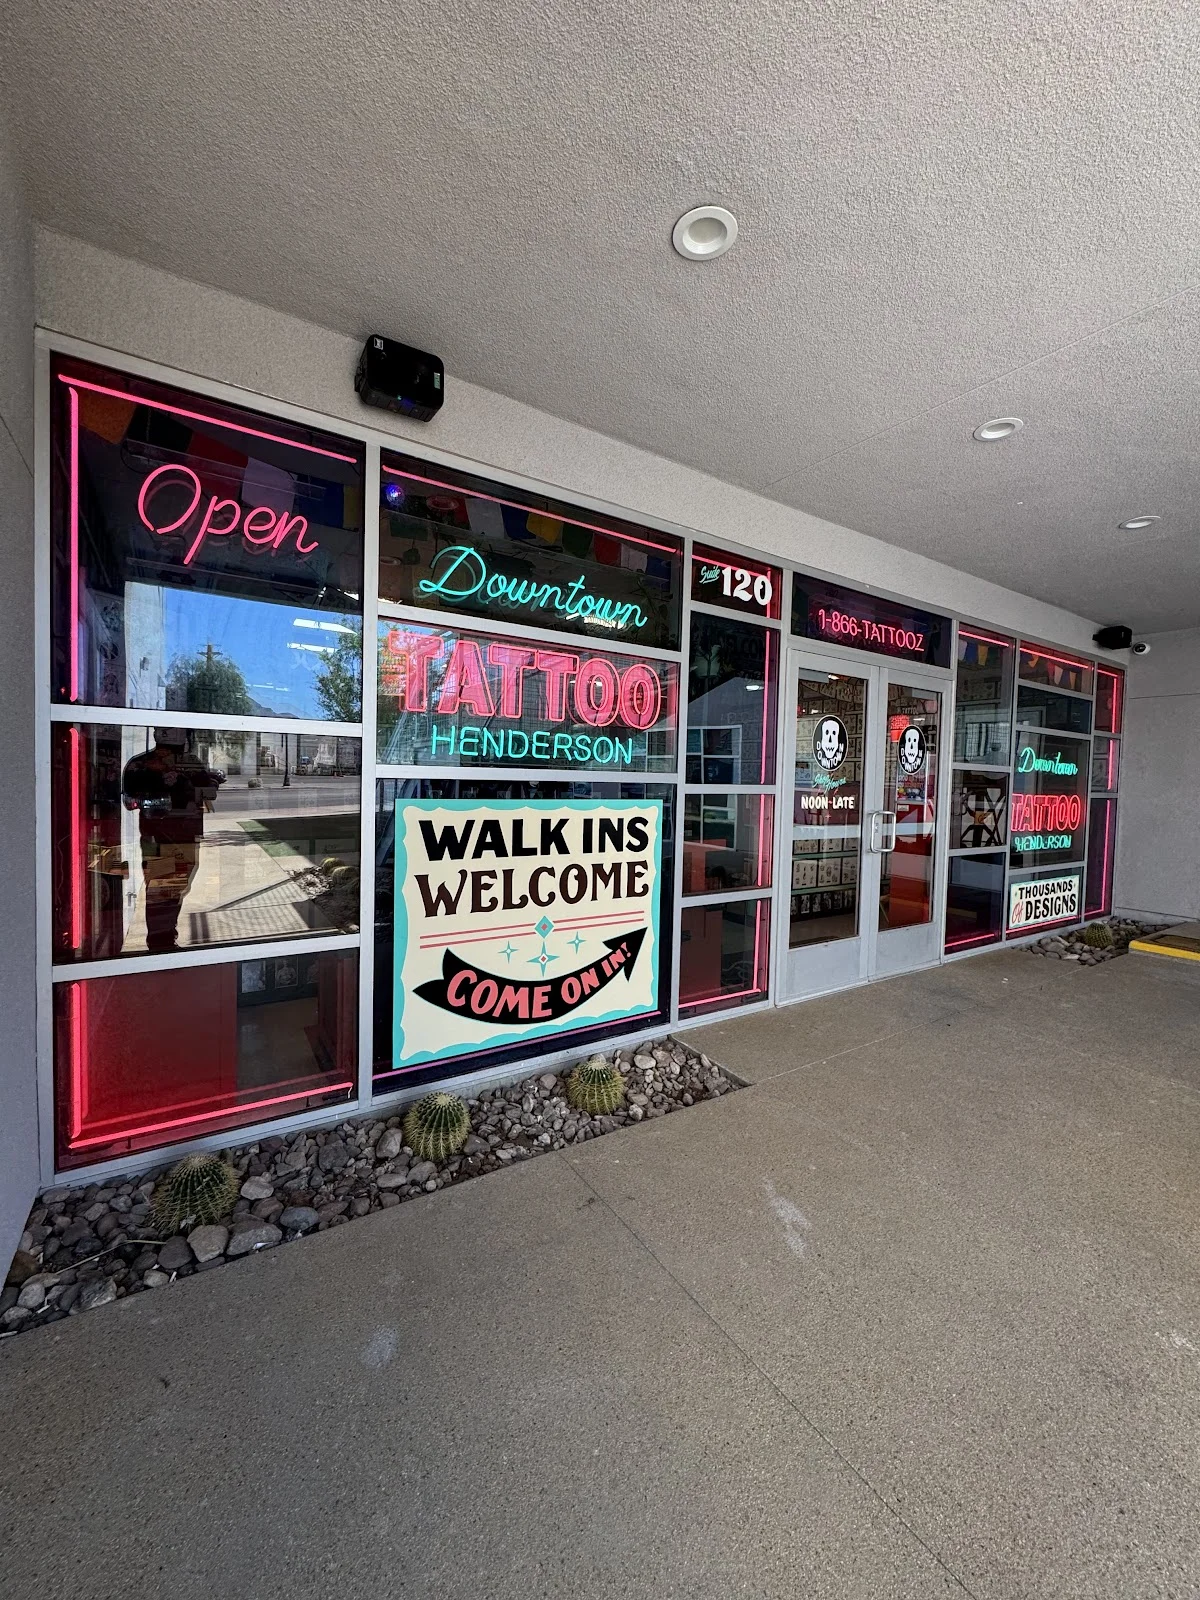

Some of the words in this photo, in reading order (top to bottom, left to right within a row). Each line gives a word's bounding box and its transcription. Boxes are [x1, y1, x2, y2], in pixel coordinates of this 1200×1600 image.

[138, 464, 319, 564] Open
[418, 546, 648, 628] Downtown
[722, 566, 772, 606] 120
[818, 608, 925, 652] 1-866-TATTOOZ
[388, 630, 663, 730] TATTOO
[431, 724, 633, 765] HENDERSON
[801, 796, 829, 810] NOON
[832, 796, 855, 810] LATE
[1011, 794, 1081, 832] TATTOO
[418, 817, 570, 862] WALK
[582, 816, 649, 854] INS
[1014, 835, 1072, 852] HENDERSON
[414, 859, 649, 918] WELCOME
[1018, 880, 1073, 900] THOUSANDS
[1025, 894, 1077, 921] DESIGNS
[446, 969, 552, 1019] COME
[560, 969, 600, 1005] ON
[602, 942, 632, 978] IN!
